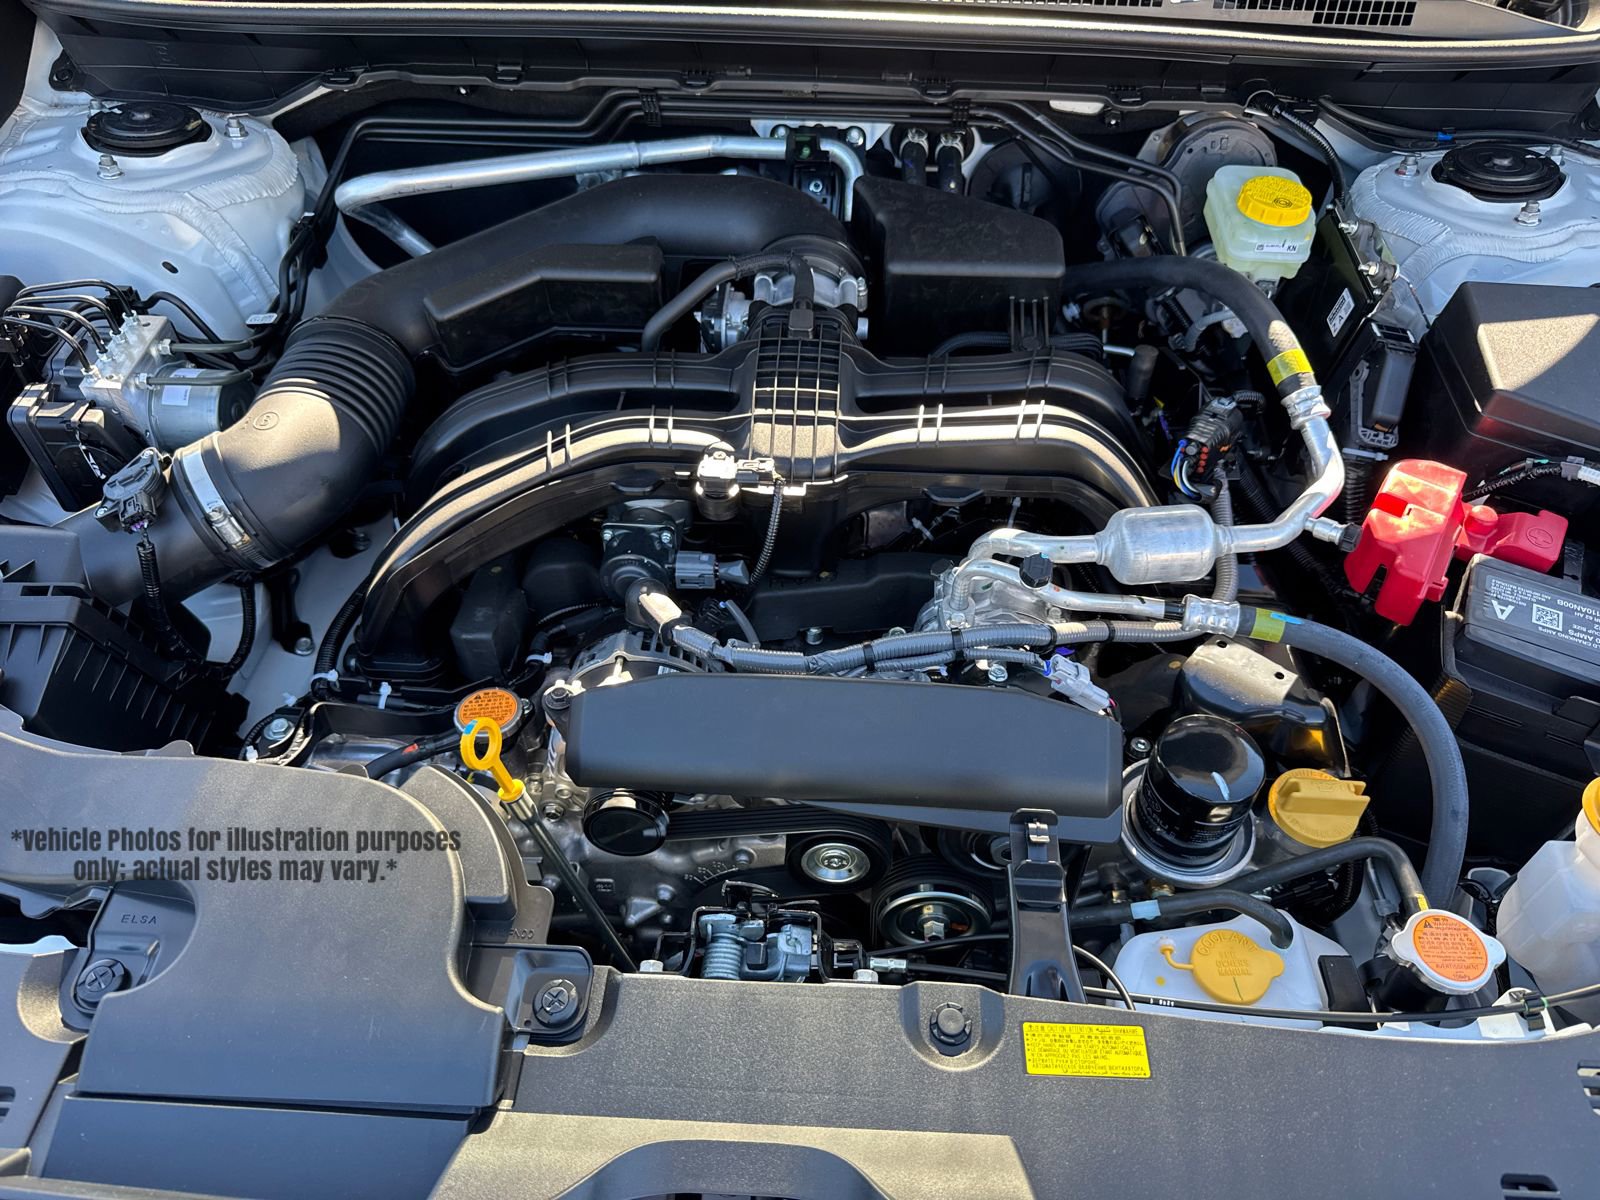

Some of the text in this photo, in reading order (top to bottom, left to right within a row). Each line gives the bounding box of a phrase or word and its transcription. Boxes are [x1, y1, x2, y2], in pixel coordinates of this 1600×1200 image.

[1491, 599, 1515, 620] A
[1537, 626, 1557, 636] AMPS
[1568, 629, 1594, 642] AMPS
[1557, 632, 1592, 647] CRANKING
[121, 914, 158, 925] ELSA
[1196, 930, 1258, 957] COOLANT
